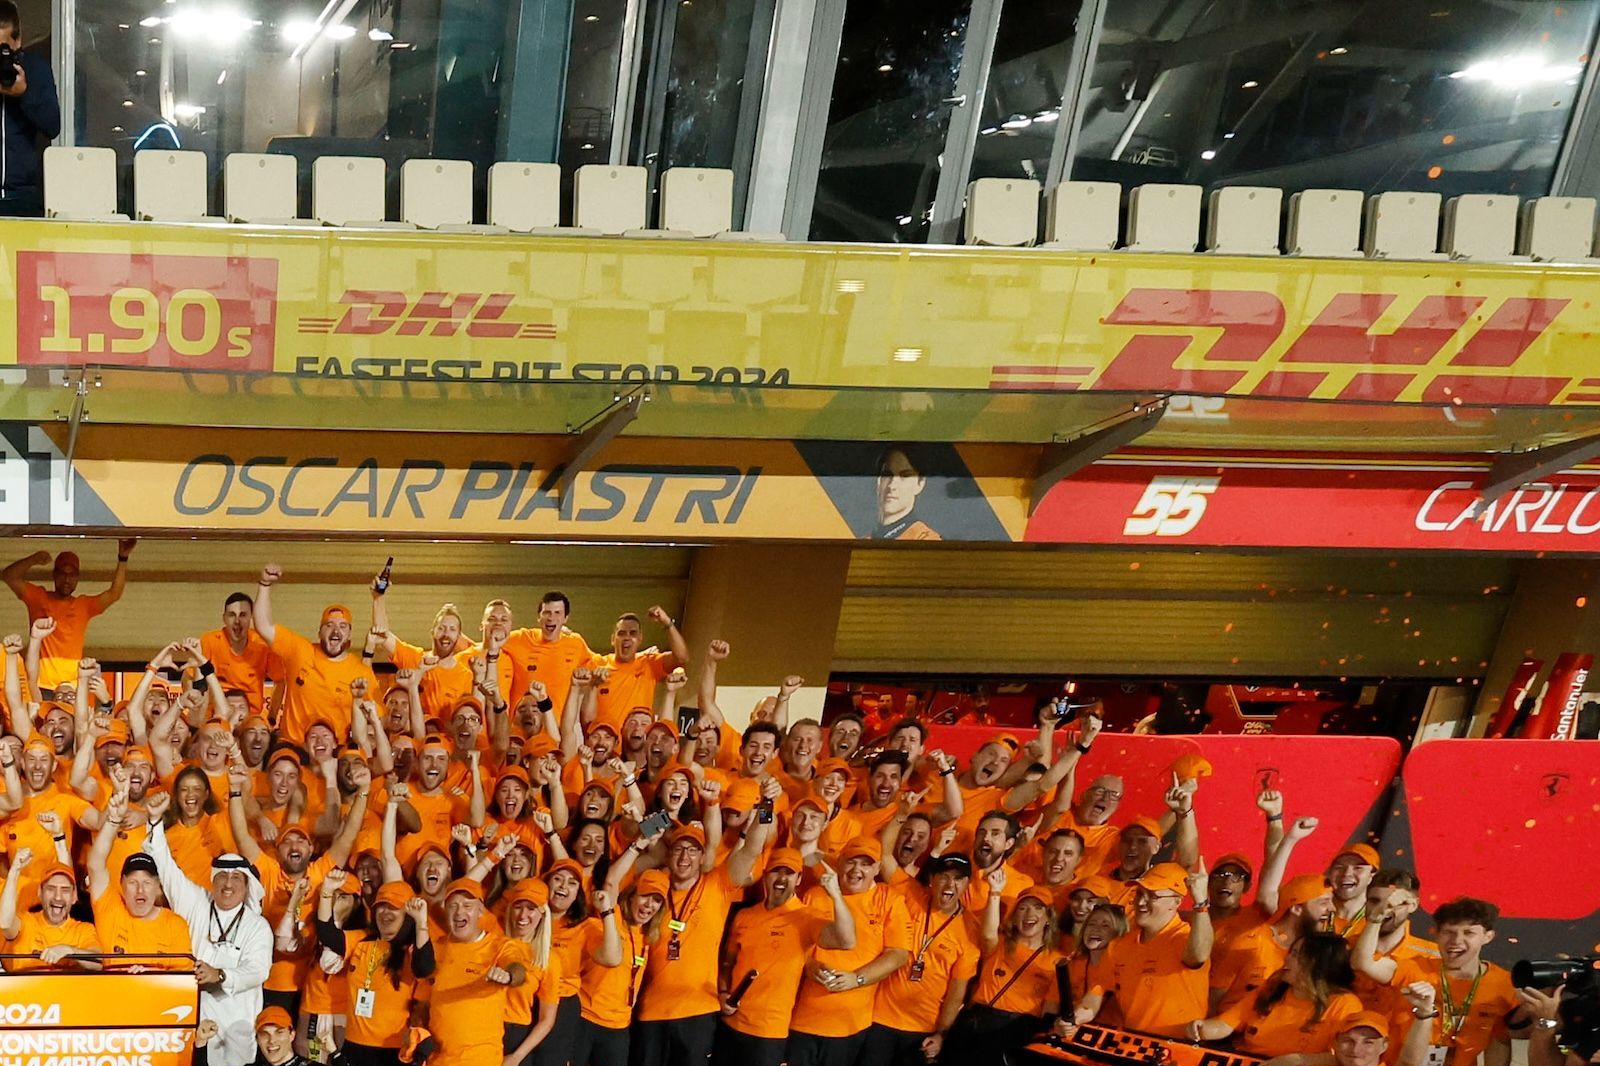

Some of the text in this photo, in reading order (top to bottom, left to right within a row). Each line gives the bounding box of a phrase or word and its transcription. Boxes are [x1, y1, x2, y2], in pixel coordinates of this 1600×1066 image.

[329, 288, 526, 339] DHL
[1094, 288, 1572, 405] DHL
[174, 453, 762, 524] OSCAR PIASTRI
[1123, 475, 1222, 536] 55
